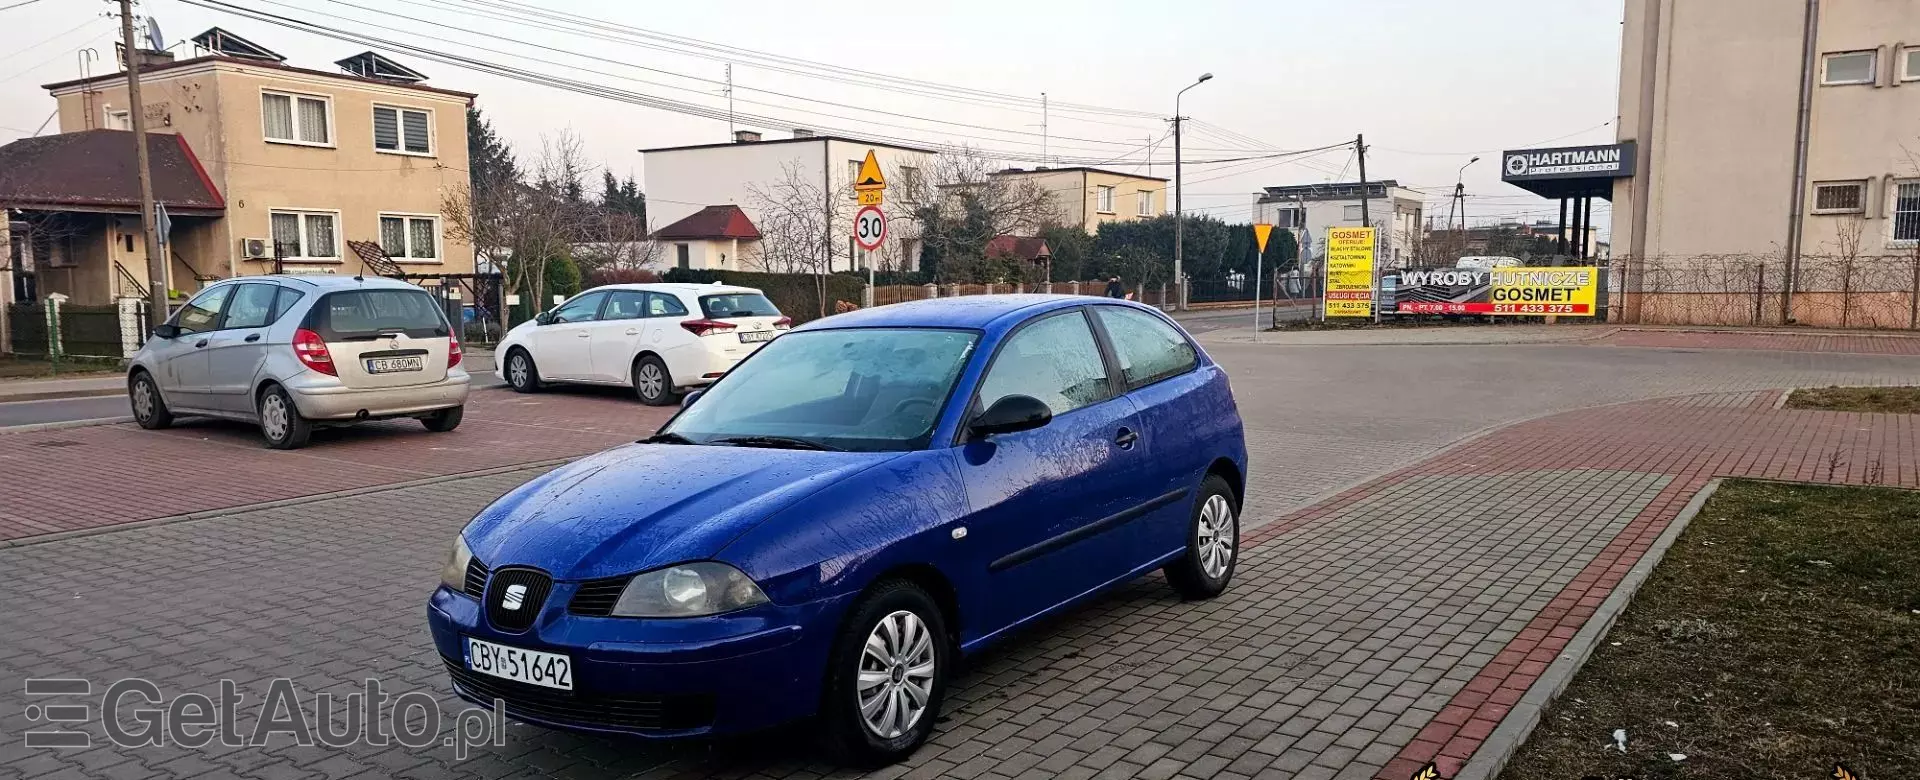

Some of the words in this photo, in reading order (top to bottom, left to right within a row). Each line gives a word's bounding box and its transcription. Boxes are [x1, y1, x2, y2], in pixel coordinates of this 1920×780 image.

[1529, 148, 1621, 166] HARTMANN
[1529, 163, 1619, 175] Professional
[238, 200, 245, 208] 6
[865, 194, 875, 202] 20
[859, 217, 881, 238] 30
[1331, 231, 1372, 239] GOSMET
[1400, 270, 1485, 286] WYROBY
[1489, 270, 1590, 286] HUTNICZE
[1493, 287, 1575, 302] GOSMET
[1494, 304, 1515, 312] 511
[1520, 304, 1545, 312] 433
[1548, 304, 1574, 312] 375
[375, 360, 388, 370] CB
[391, 358, 420, 369] 680MN
[470, 641, 501, 674] CBY
[507, 648, 571, 688] 51642
